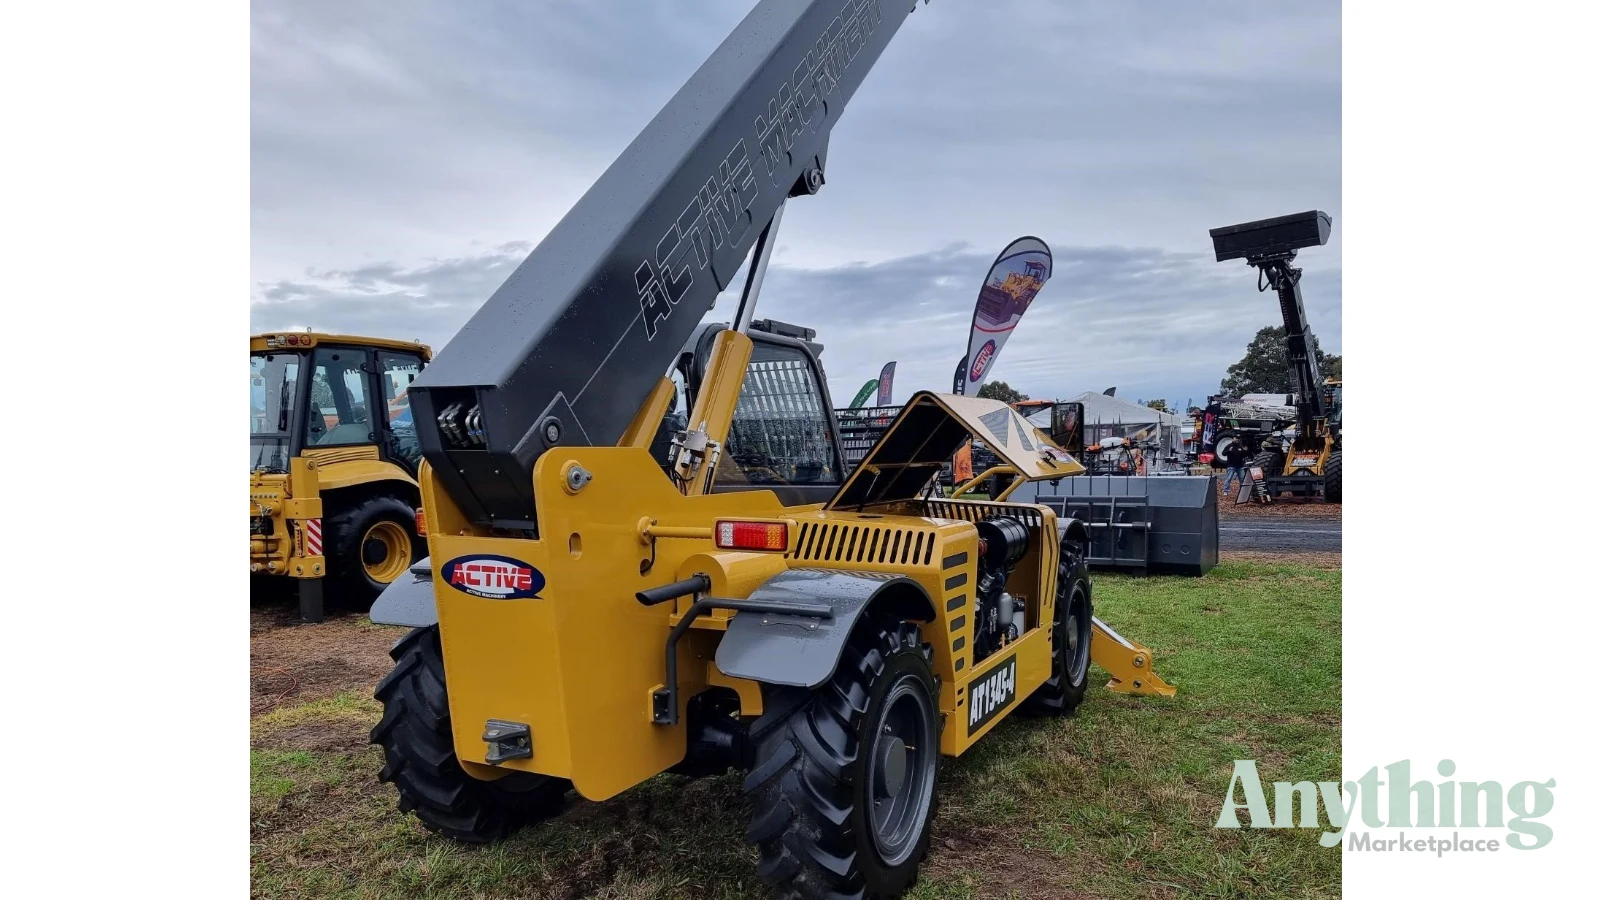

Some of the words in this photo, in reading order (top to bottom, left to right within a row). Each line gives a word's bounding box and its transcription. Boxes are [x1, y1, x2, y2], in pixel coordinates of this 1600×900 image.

[635, 138, 758, 341] ACTIVE
[451, 563, 532, 590] ACTIVE
[466, 588, 481, 597] ACTIVE
[970, 662, 1015, 726] AT1345-4
